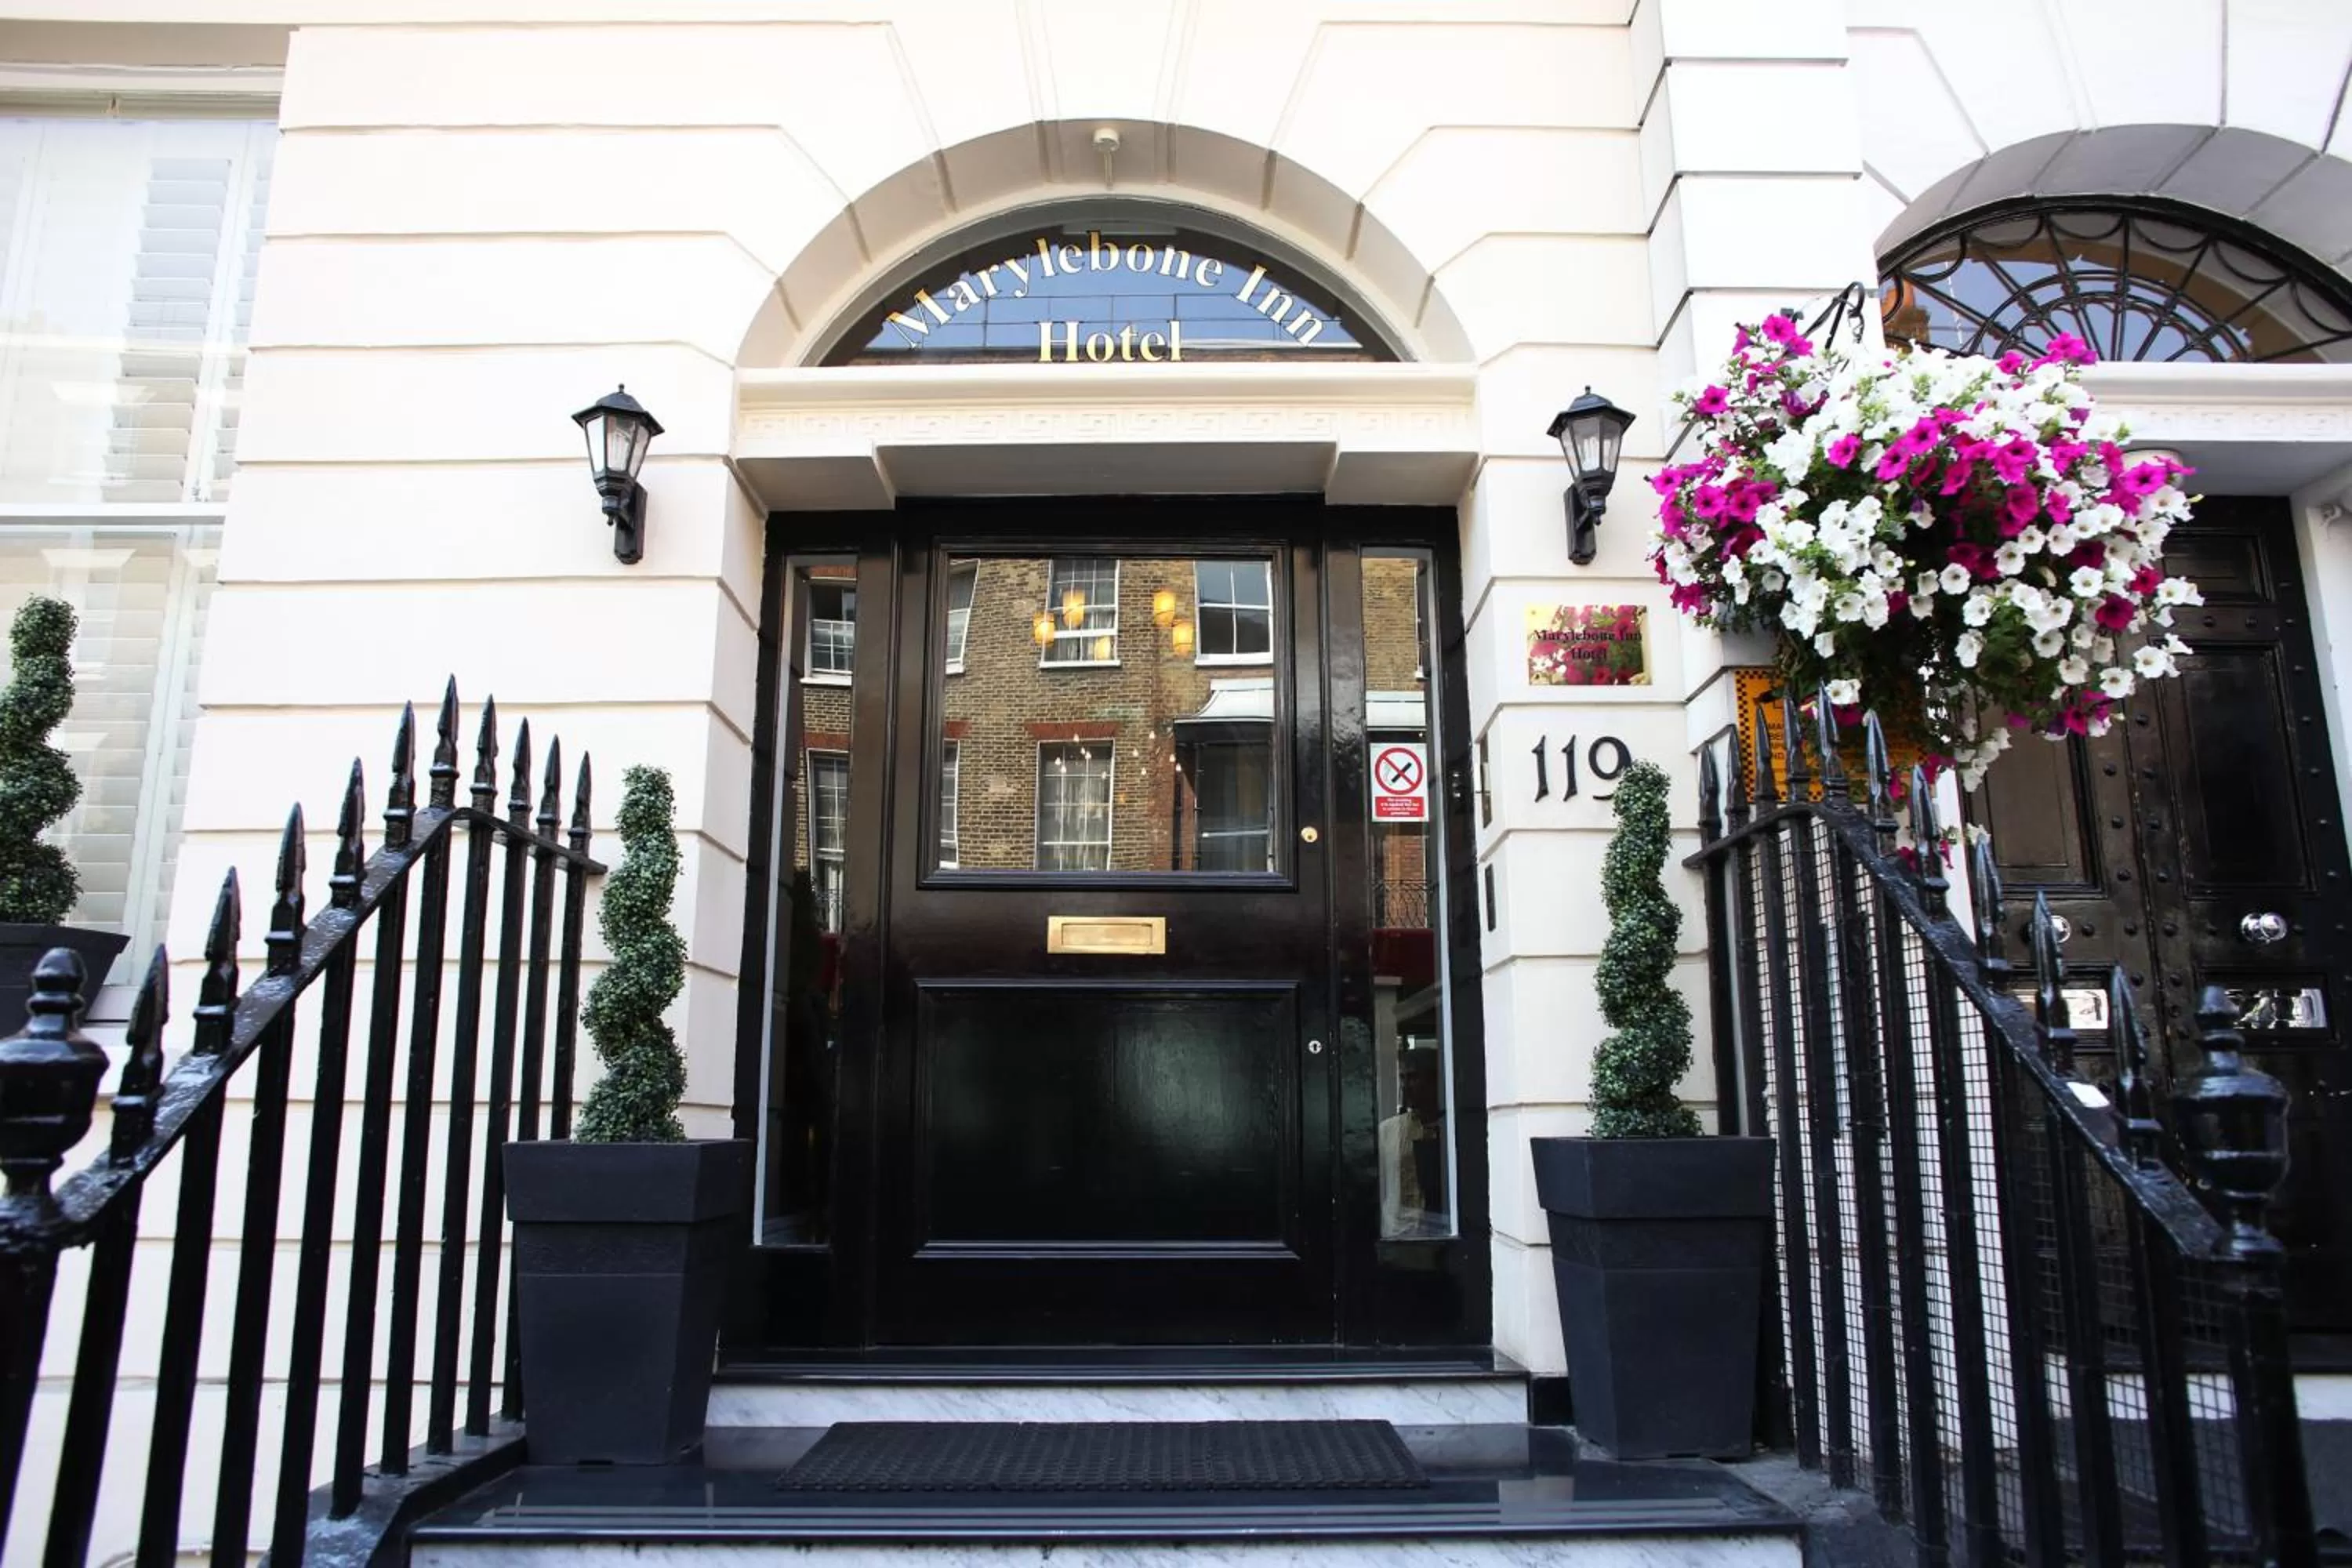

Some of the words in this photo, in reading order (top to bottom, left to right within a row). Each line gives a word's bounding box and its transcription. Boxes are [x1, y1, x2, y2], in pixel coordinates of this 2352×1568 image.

[886, 230, 1225, 349] Marylebone
[1234, 263, 1323, 347] Inn
[1036, 320, 1185, 362] Hotel
[1531, 734, 1632, 803] 119
